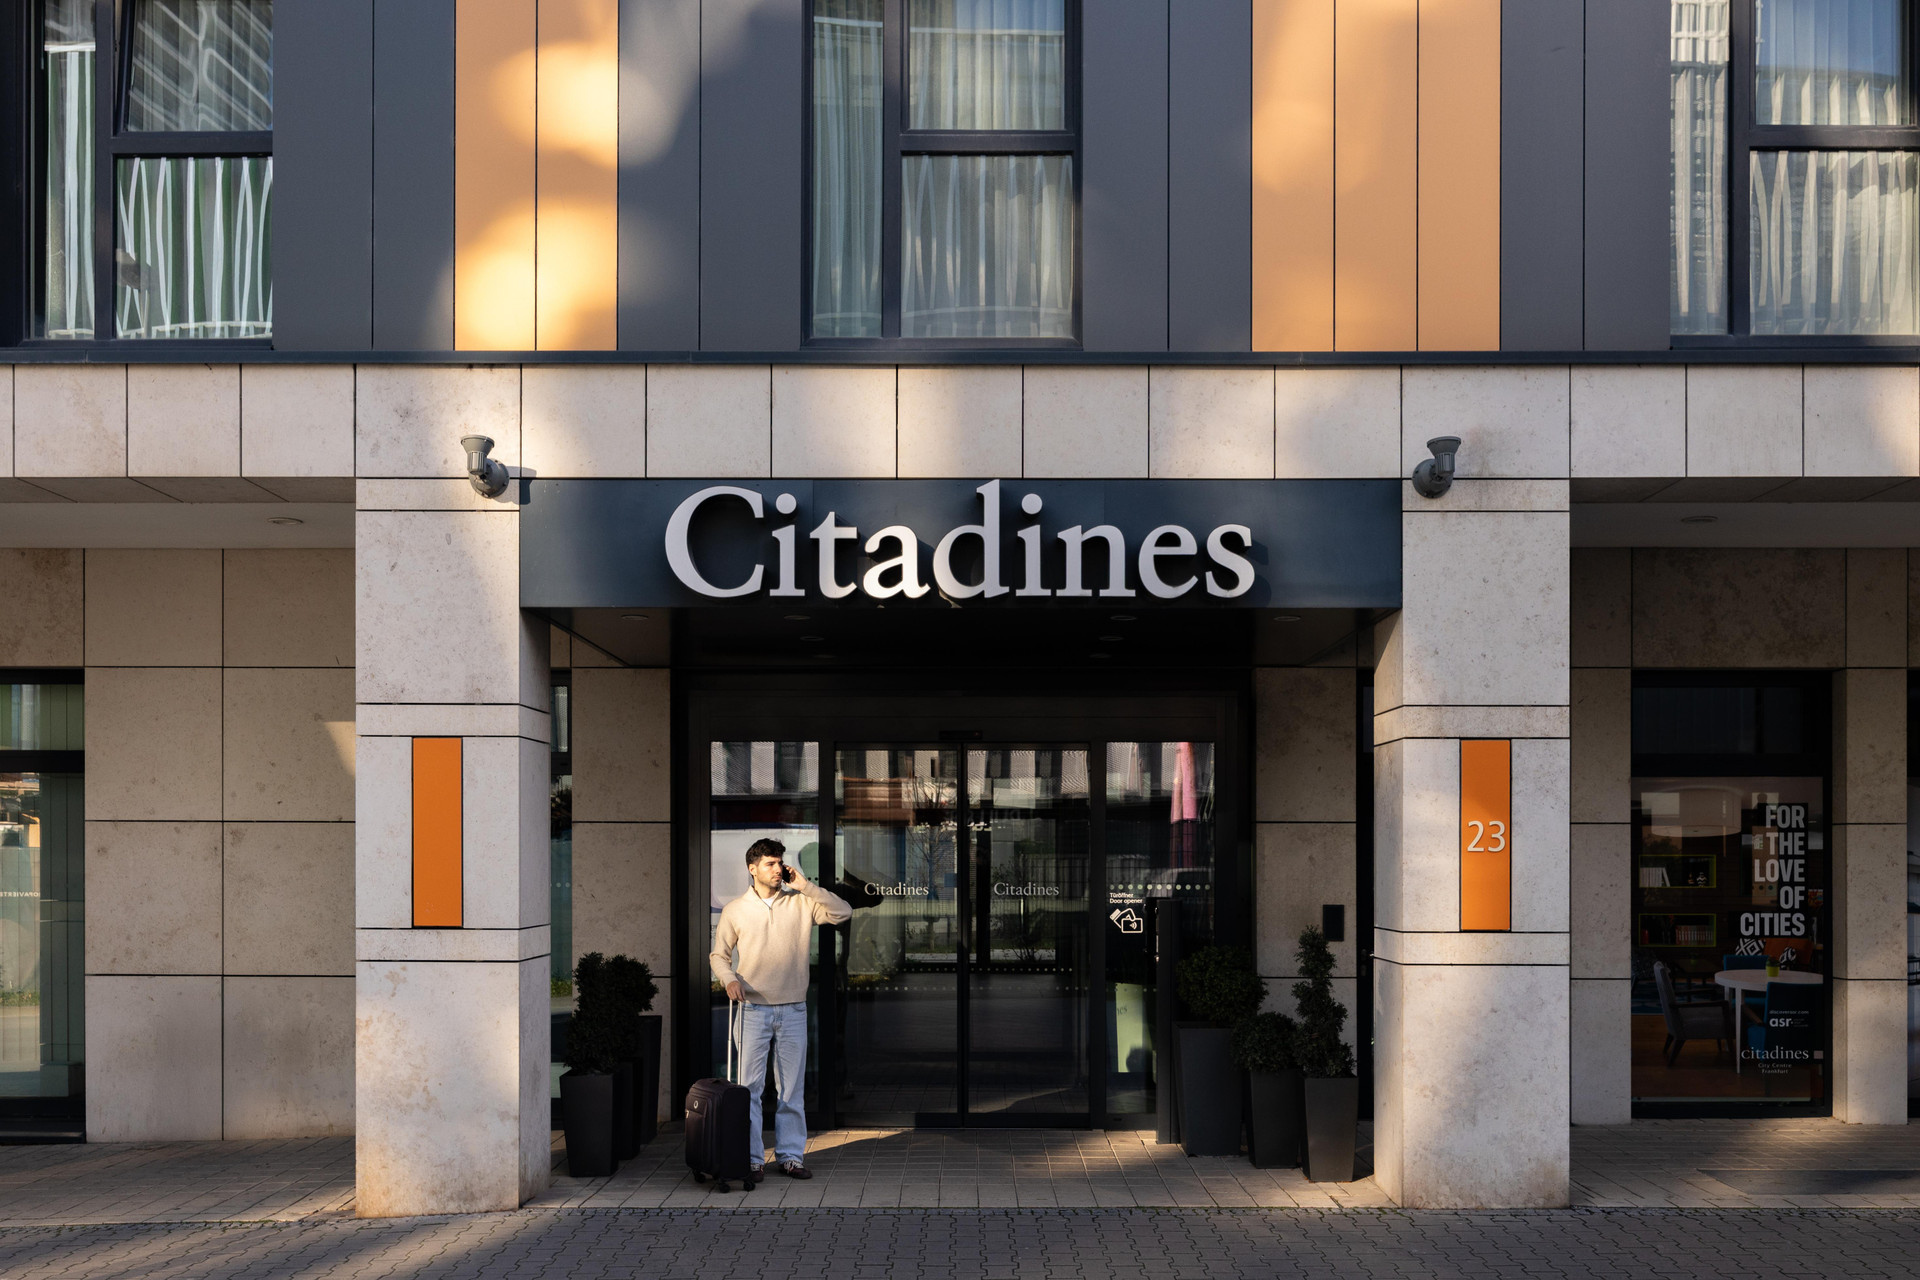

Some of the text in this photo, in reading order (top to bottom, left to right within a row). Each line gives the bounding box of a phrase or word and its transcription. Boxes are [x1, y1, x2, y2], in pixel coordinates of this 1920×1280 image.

[664, 479, 1255, 601] Citadines
[1765, 805, 1805, 829] FOR
[1467, 820, 1506, 853] 23
[1766, 832, 1805, 855] THE
[1754, 859, 1805, 883] LOVE
[864, 882, 929, 896] Citadines
[993, 882, 1060, 896] Citadines
[1779, 885, 1805, 910] OF
[1740, 912, 1805, 937] CITIES
[1741, 1045, 1809, 1060] citadines
